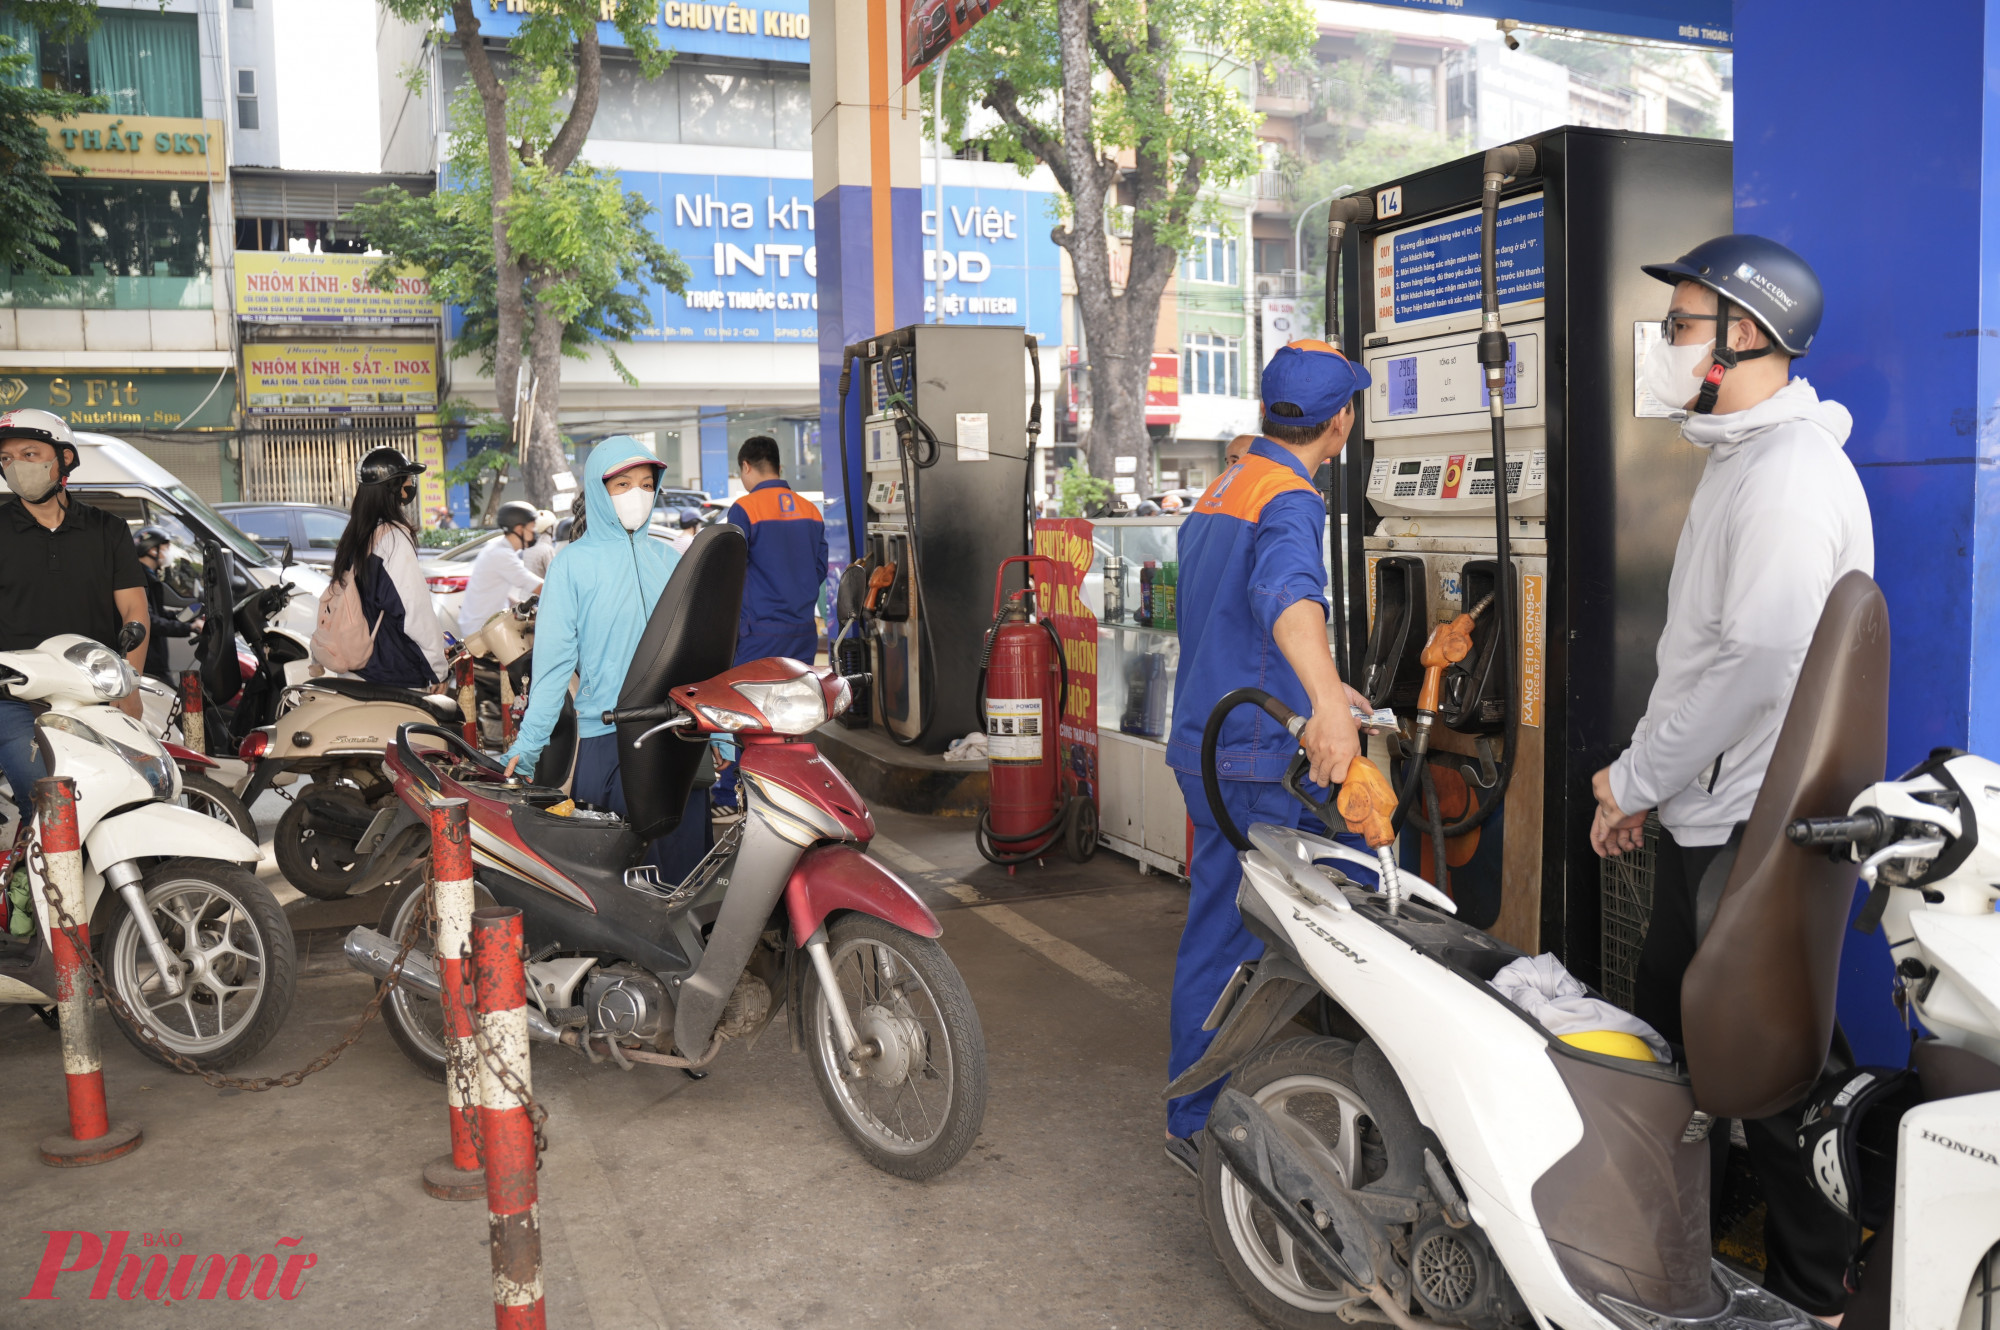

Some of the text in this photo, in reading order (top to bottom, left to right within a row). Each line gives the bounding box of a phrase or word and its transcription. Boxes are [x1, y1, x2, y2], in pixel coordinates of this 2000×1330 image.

[665, 1, 757, 35] CHUYÊN
[764, 10, 810, 39] KHO
[60, 119, 143, 152] THẤT
[155, 132, 212, 154] SKY
[1381, 191, 1398, 214] 14
[675, 194, 753, 229] Nha
[767, 195, 814, 230] kh
[950, 205, 1017, 243] Việt
[1401, 242, 1415, 251] Hướng
[1425, 236, 1439, 245] khách
[1440, 232, 1451, 241] hàng
[1513, 214, 1526, 223] nhận
[1527, 211, 1537, 220] nhu
[1380, 245, 1390, 258] QUY
[1409, 253, 1422, 262] khách
[1410, 265, 1423, 274] khách
[1424, 262, 1435, 271] hàng
[1445, 257, 1456, 268] nhận
[1501, 245, 1513, 254] đang
[247, 270, 294, 292] NHÔM
[299, 271, 339, 293] KÍNH
[1378, 265, 1393, 279] TRÌNH
[1410, 291, 1423, 300] khách
[1424, 288, 1435, 296] hàng
[1445, 284, 1456, 293] nhận
[1526, 266, 1541, 276] thanh
[1412, 278, 1423, 286] hàng
[1444, 270, 1454, 278] theo
[1753, 274, 1768, 285] AN
[686, 290, 724, 312] TRỰC
[727, 288, 775, 312] THUỘC
[777, 293, 810, 310] C.TY
[968, 297, 1017, 313] INTECH
[1380, 285, 1391, 298] BÁN
[1423, 301, 1436, 309] thanh
[1463, 293, 1475, 302] nhận
[1516, 282, 1532, 292] khách
[1379, 305, 1393, 318] HÀNG
[252, 354, 431, 375] NHÔM KÍNH SẮT INOX
[49, 378, 140, 407] S Fit
[70, 410, 181, 425] Nutrition Spa
[1524, 578, 1535, 723] XĂNG E10 RON95-V
[1534, 660, 1540, 672] 07
[1292, 906, 1368, 965] VISION
[1921, 1129, 2000, 1166] HONDA
